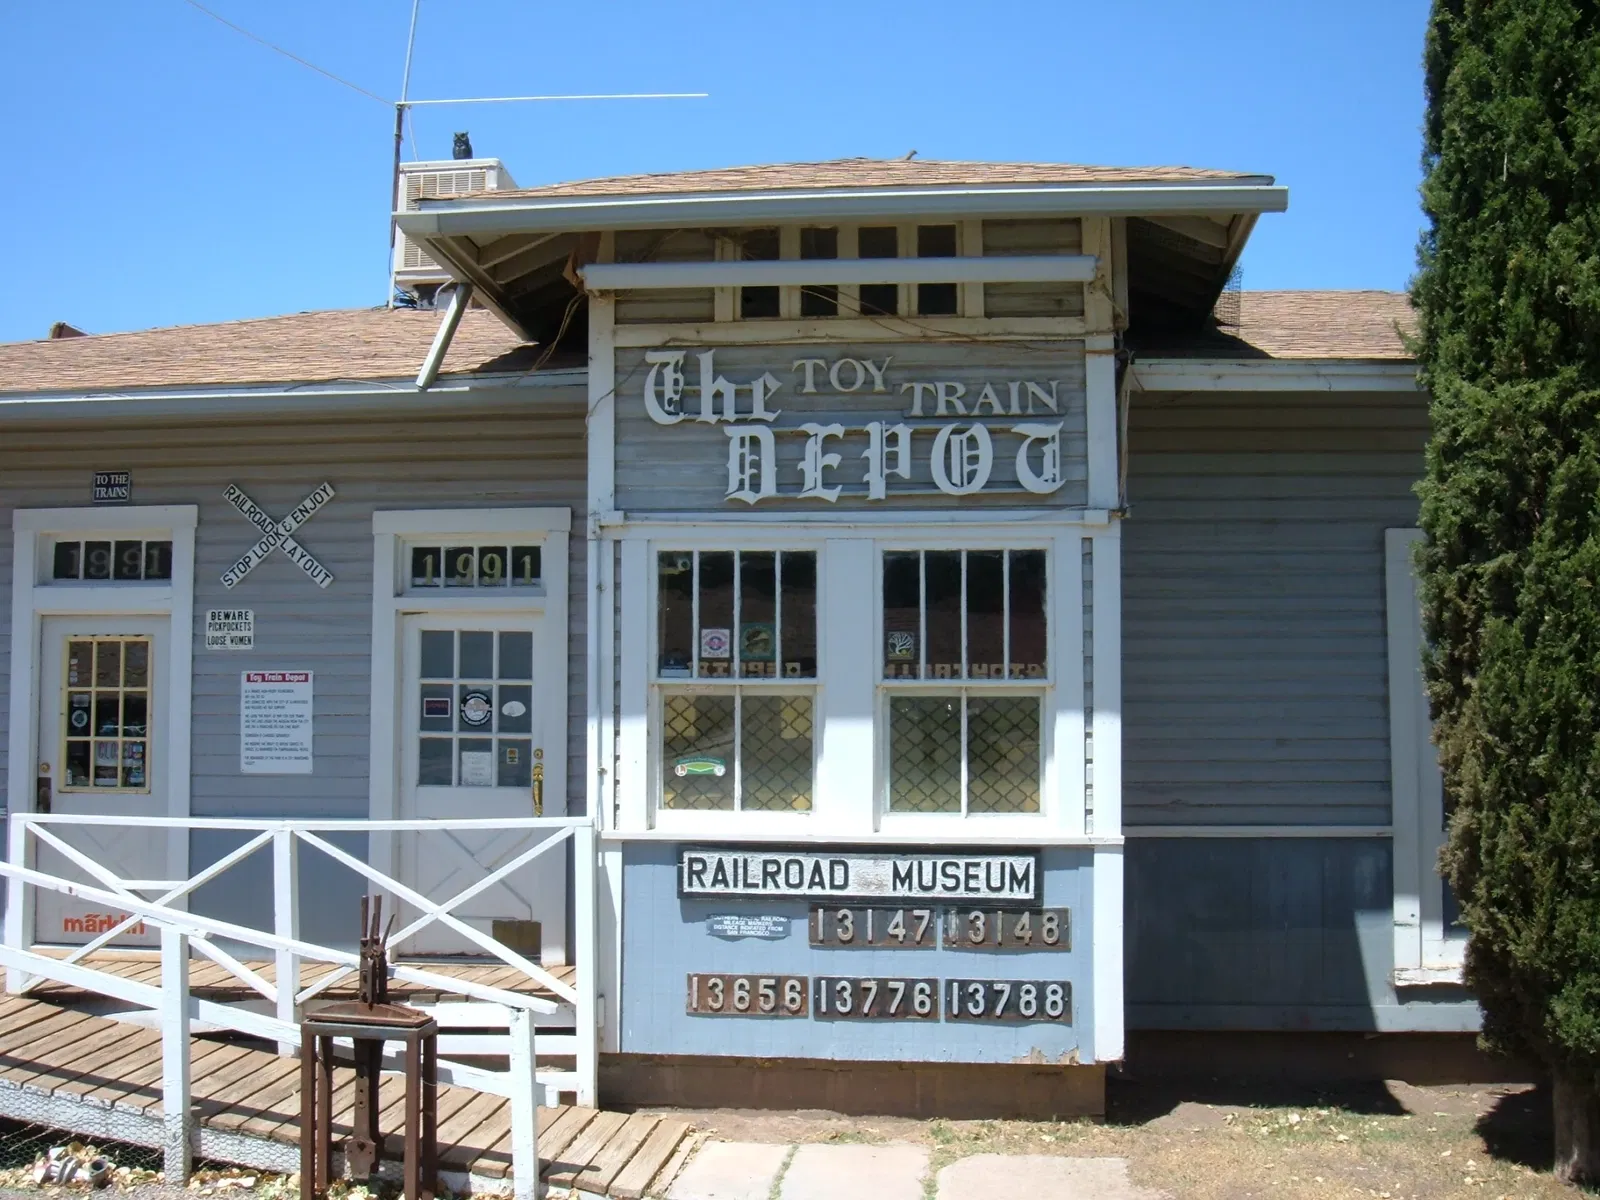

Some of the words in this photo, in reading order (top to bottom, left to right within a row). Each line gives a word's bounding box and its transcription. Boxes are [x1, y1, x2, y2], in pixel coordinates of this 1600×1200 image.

[644, 349, 783, 426] The
[792, 356, 893, 393] TOY
[900, 380, 1059, 417] TRAIN
[96, 475, 108, 485] TO
[110, 474, 129, 484] THE
[723, 420, 1067, 505] DEPOT
[95, 487, 127, 498] TRAINS
[223, 556, 252, 587] STOP
[252, 527, 285, 560] LOOK
[290, 485, 331, 525] ENJOY
[224, 486, 275, 535] RAILROAD
[280, 537, 331, 585] LAYOUT
[423, 553, 533, 585] 1991
[208, 622, 252, 632] PICKPOCKETS
[211, 611, 249, 621] BEWARE
[207, 636, 227, 646] LOOSE
[230, 636, 252, 646] WOMEN
[250, 674, 262, 683] Toy
[265, 674, 282, 682] Train
[286, 674, 306, 683] Depot
[687, 856, 850, 890] RAILROAD
[892, 861, 1031, 893] MUSEUM
[815, 907, 931, 943] 13147
[948, 908, 1060, 944] 13148
[690, 976, 803, 1011] 13656
[820, 980, 932, 1014] 13776
[951, 982, 1064, 1018] 13788
